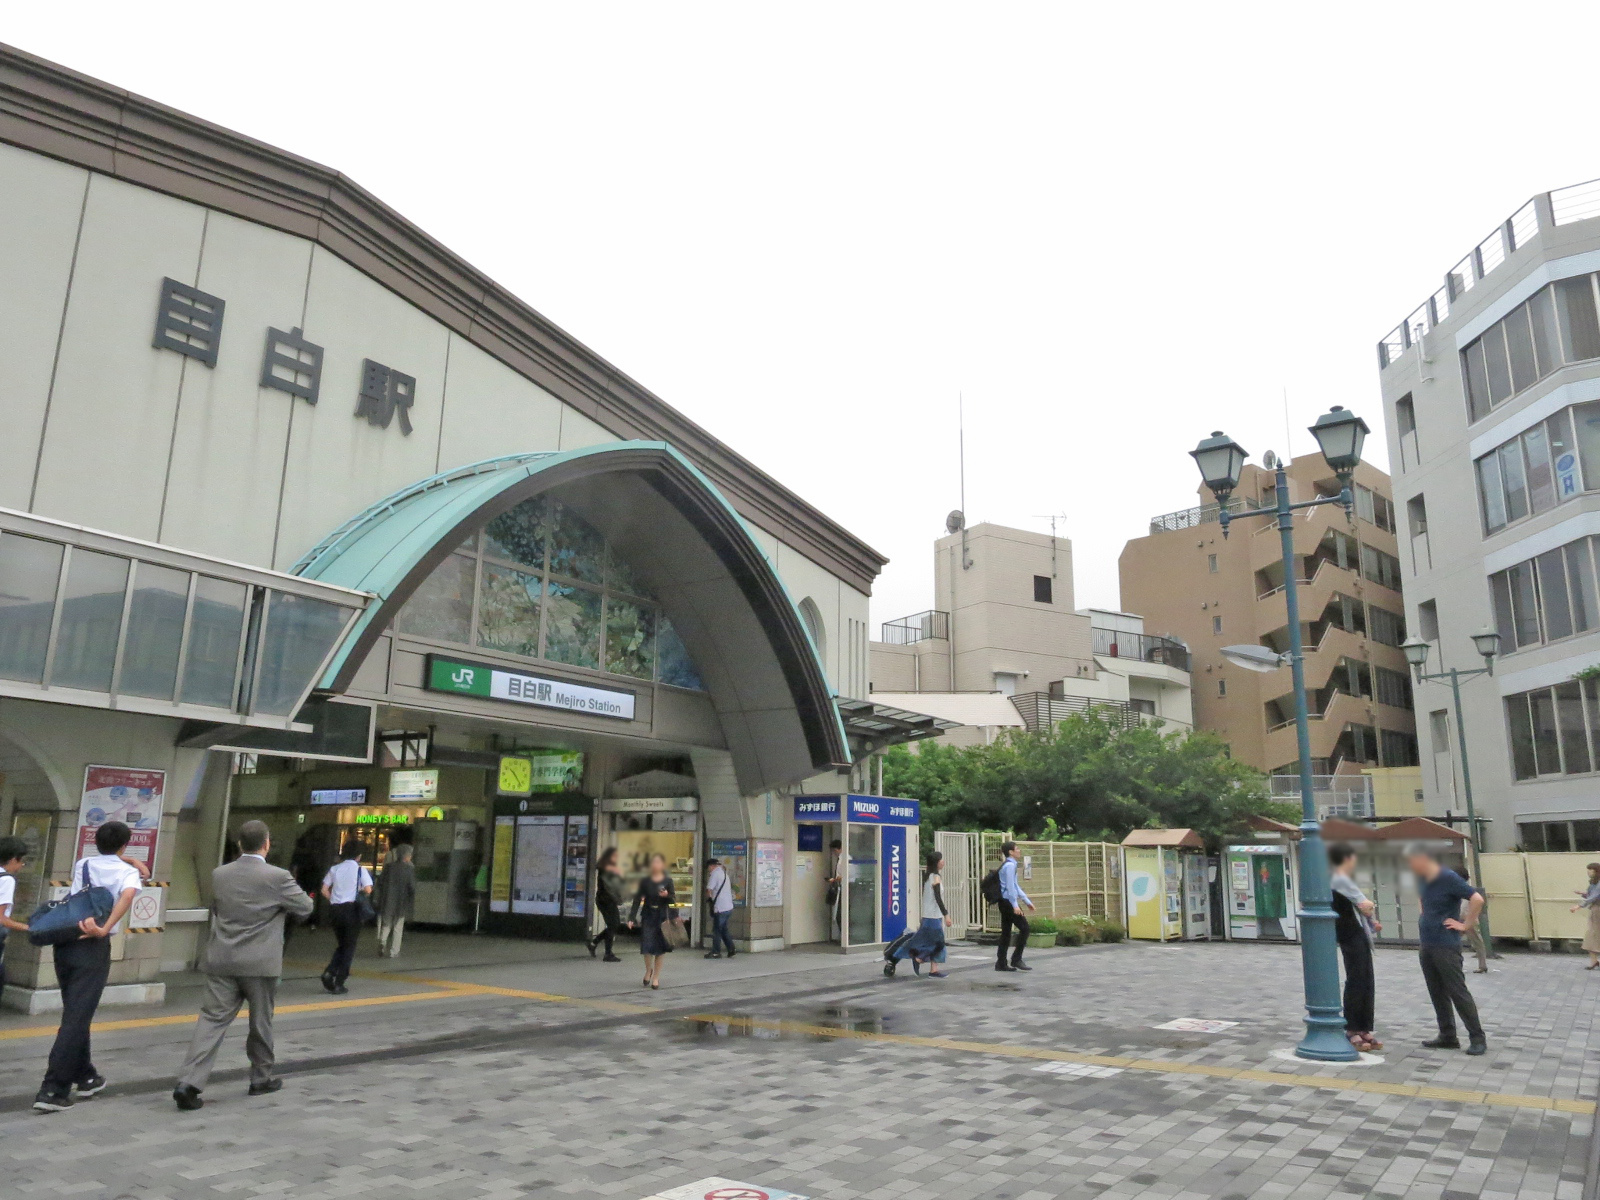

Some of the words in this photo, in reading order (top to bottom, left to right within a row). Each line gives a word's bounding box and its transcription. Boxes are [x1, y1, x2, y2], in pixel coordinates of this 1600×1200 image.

[152, 276, 417, 437] 目白駅
[452, 668, 474, 685] JR
[508, 677, 552, 702] 目白駅
[556, 693, 586, 709] Mejiro
[588, 698, 621, 714] Station
[799, 802, 836, 811] みずほ銀行
[853, 801, 880, 813] MIZUHO
[889, 806, 914, 817] みずほ銀行
[356, 814, 389, 824] HONEY'S
[390, 814, 408, 824] BAR
[892, 845, 900, 916] MIZUHO
